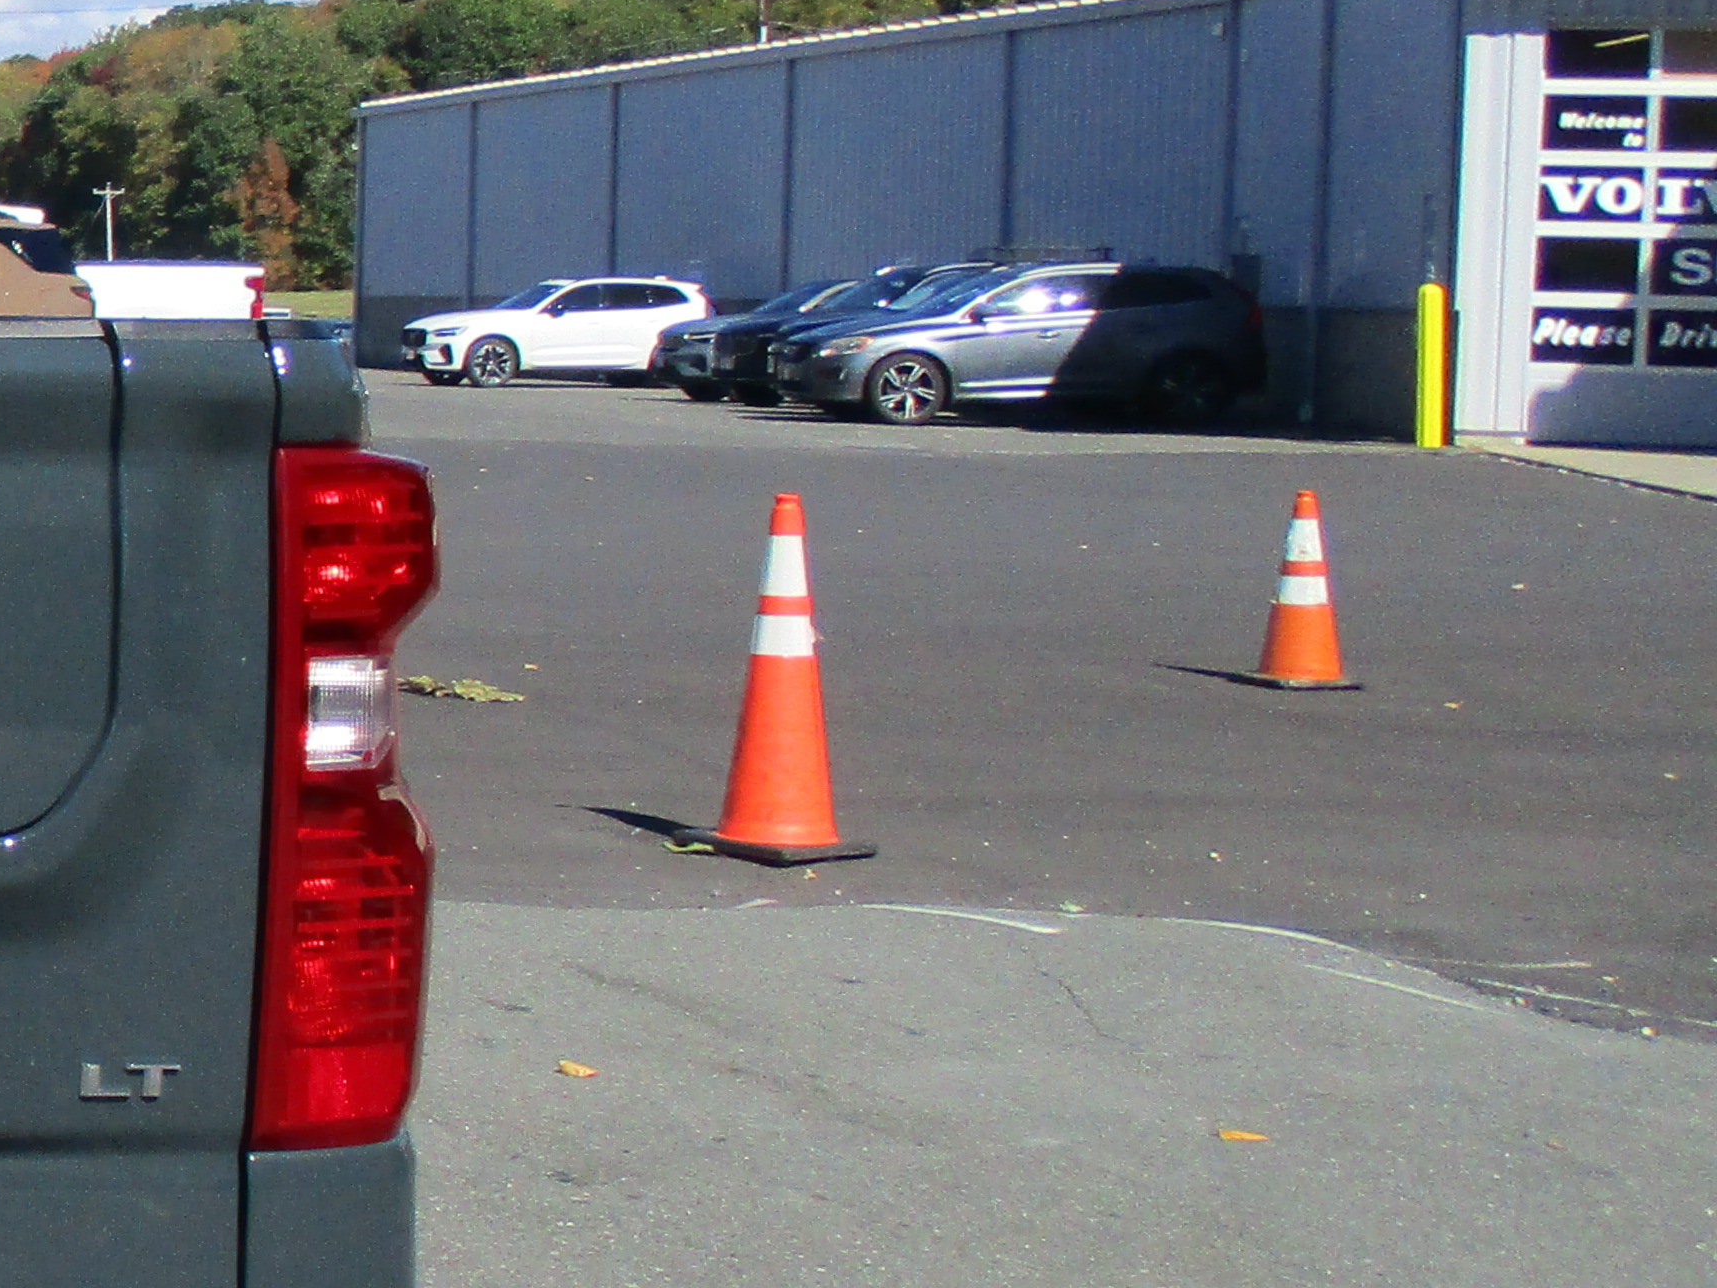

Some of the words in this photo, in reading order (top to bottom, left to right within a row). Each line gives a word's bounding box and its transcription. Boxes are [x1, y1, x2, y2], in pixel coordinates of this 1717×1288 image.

[1559, 112, 1645, 130] Welcome
[1622, 132, 1645, 147] to
[1532, 317, 1632, 347] Please
[78, 1062, 183, 1102] LT
